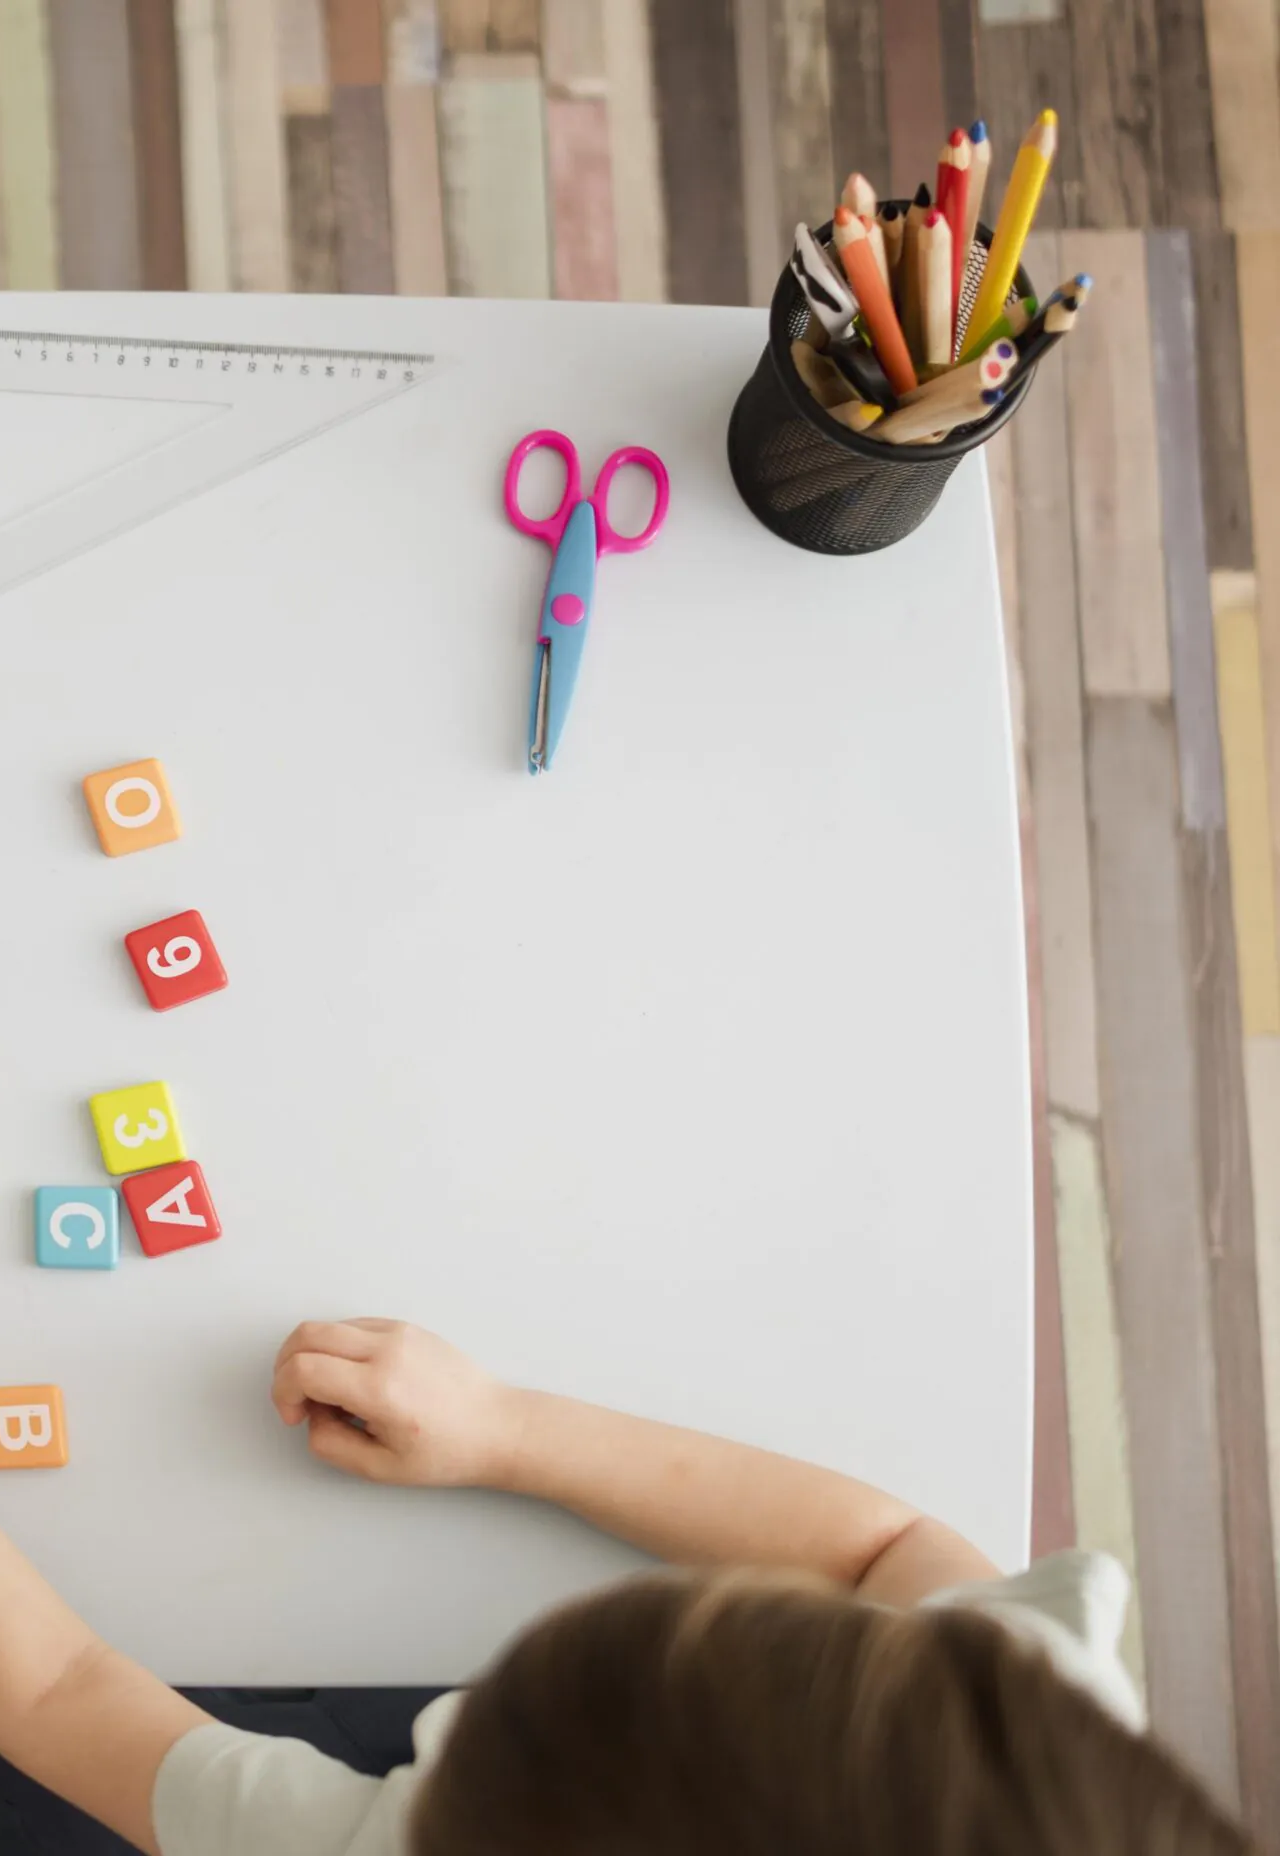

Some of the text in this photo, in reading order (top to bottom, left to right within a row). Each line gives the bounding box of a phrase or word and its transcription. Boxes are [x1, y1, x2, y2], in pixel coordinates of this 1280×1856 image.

[114, 1108, 168, 1149] 3
[49, 1202, 107, 1250] C
[145, 1176, 207, 1228] A
